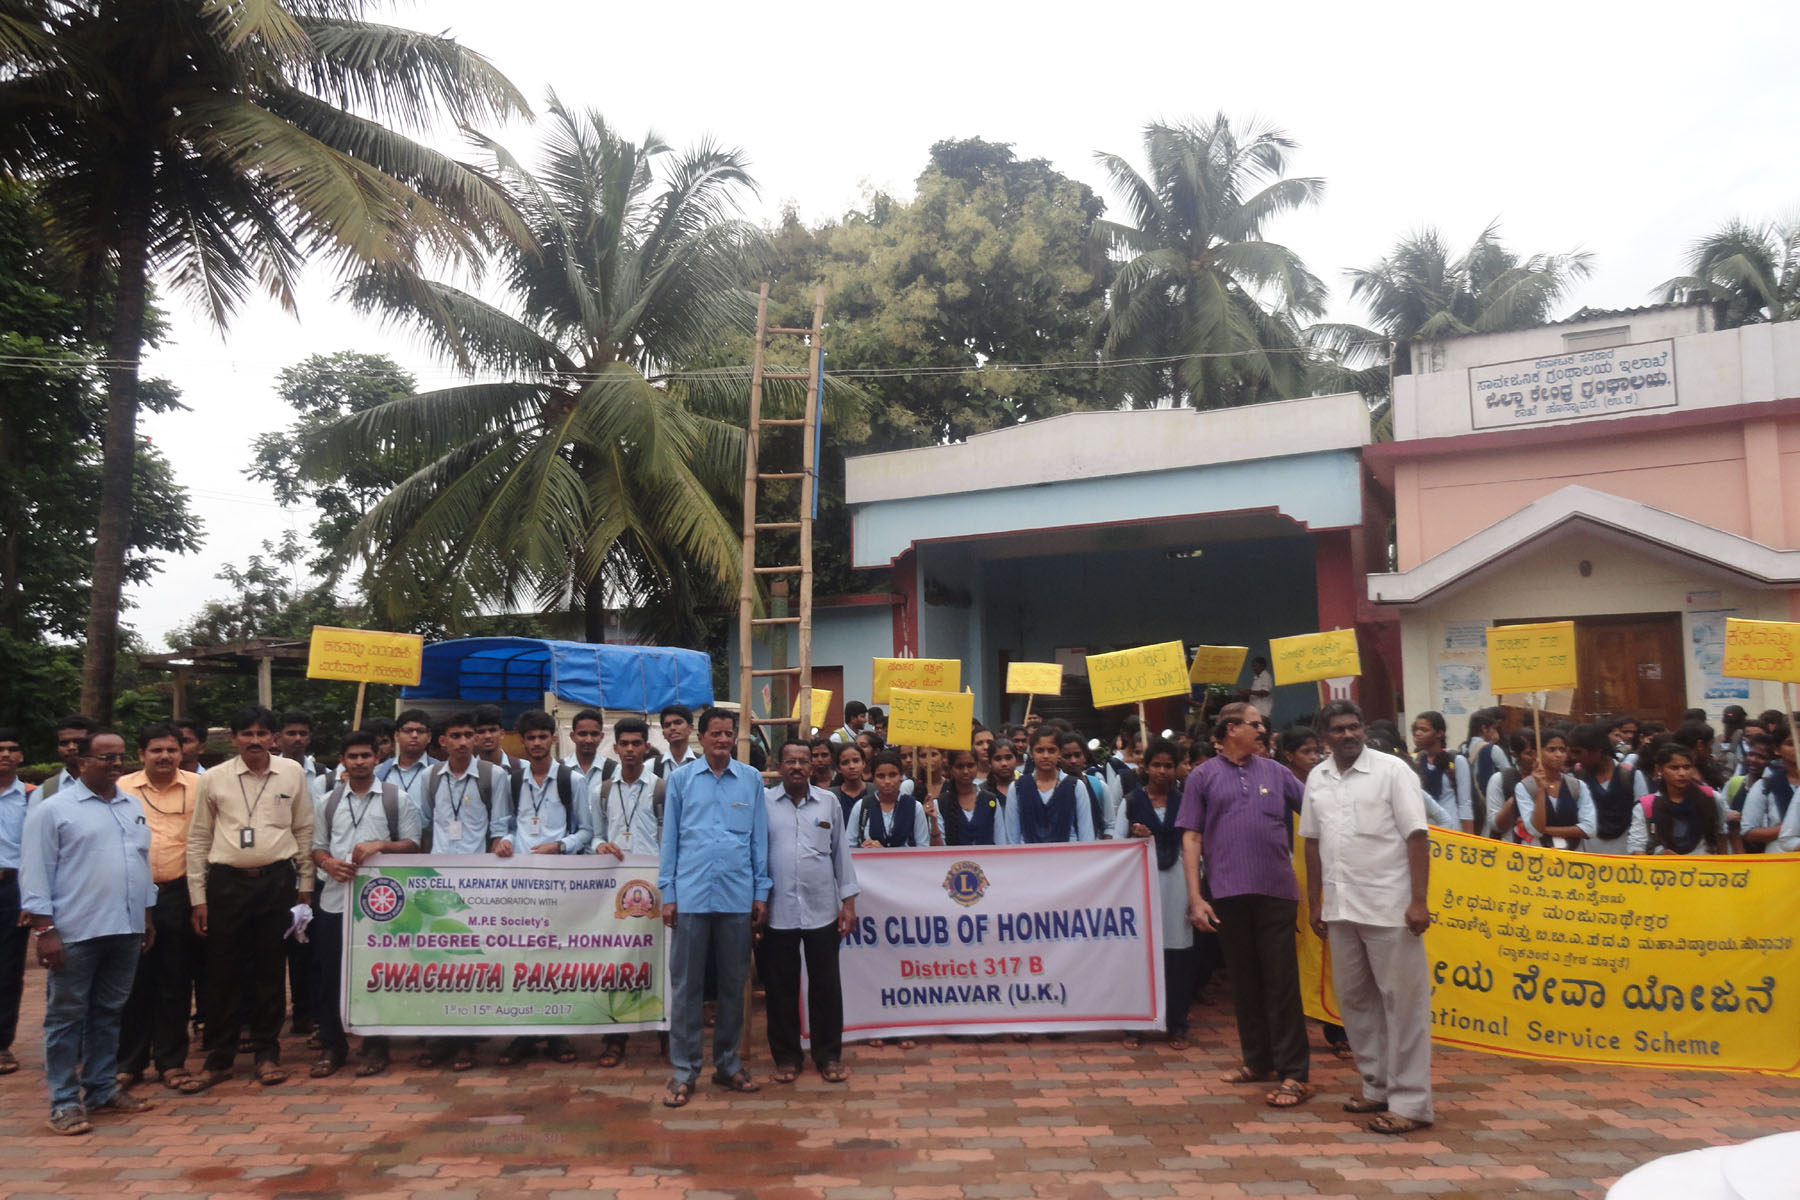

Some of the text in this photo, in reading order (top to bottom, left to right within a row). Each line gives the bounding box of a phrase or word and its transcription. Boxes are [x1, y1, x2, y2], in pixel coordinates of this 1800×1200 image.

[1619, 351, 1668, 373] ಇಲಾಖೆ
[408, 878, 617, 892] NSS CELL, KARNATAK UNIVERSITY, DHARWAD
[467, 896, 536, 906] COLLABORATION
[538, 897, 558, 906] WITH
[468, 916, 550, 929] M.P.E Society's
[885, 914, 949, 946] CLUB
[957, 913, 990, 944] OF
[998, 906, 1138, 943] HONNAVAR
[367, 934, 653, 950] S.D.M DEGREE COLLEGE, HONNAVAR
[367, 962, 652, 994] SWACHHTA PAKHWARA
[901, 956, 1044, 978] District 317 B
[881, 982, 1067, 1008] HONNAVAR (U.K.)
[1512, 964, 1607, 1009] ಸೇವಾ
[1623, 974, 1777, 1014] ಯೋಜನೆ
[495, 1004, 533, 1017] August
[544, 1004, 573, 1015] 2017
[1431, 1008, 1721, 1056] tional Service Scheme
